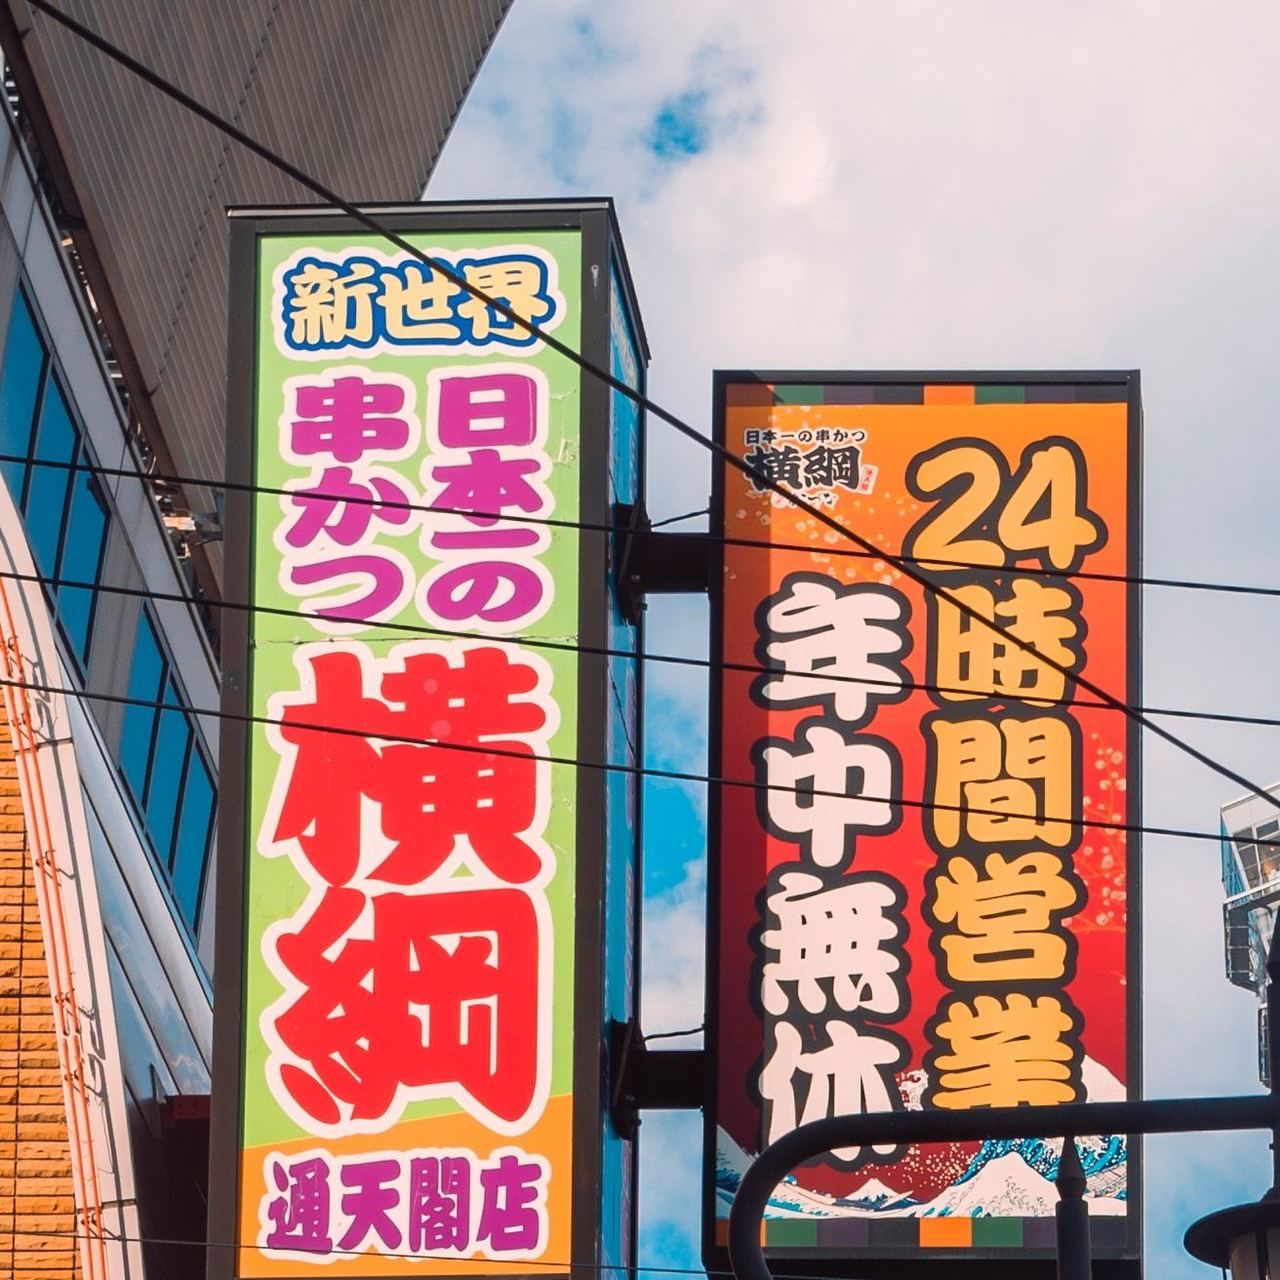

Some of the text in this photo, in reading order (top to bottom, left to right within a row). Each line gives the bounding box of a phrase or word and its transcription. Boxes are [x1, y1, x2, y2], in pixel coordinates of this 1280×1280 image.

[286, 254, 556, 348] 新世界
[287, 376, 410, 627] 串かつ
[424, 373, 542, 621] 日本一の
[745, 446, 860, 490] 横綱
[746, 430, 865, 443] 日本一の串かつ
[272, 648, 542, 1125] 横綱
[762, 582, 910, 1165] 年中無休
[266, 1156, 540, 1255] 通天閣店
